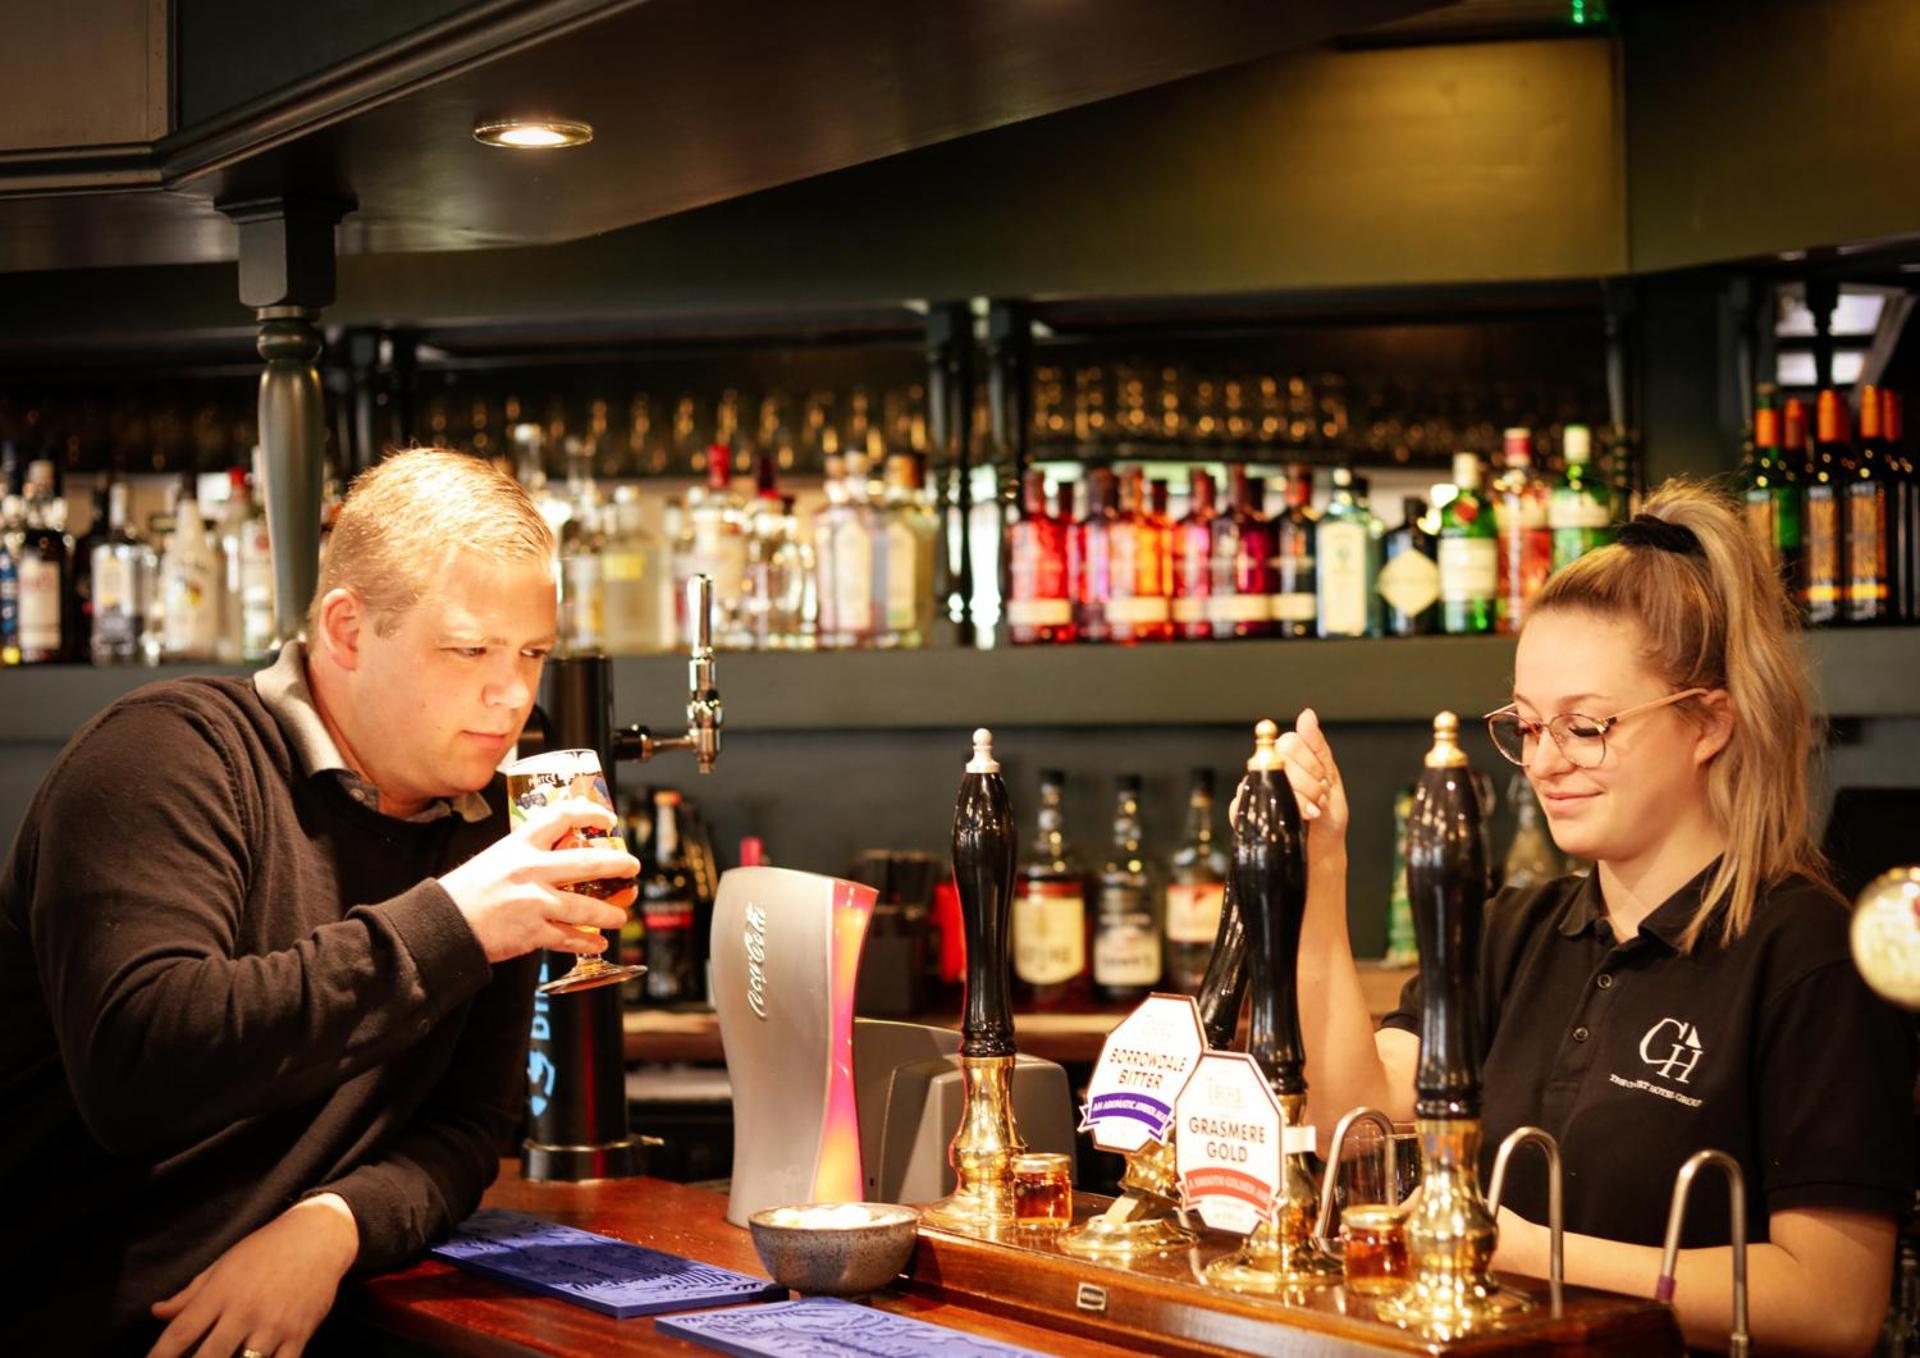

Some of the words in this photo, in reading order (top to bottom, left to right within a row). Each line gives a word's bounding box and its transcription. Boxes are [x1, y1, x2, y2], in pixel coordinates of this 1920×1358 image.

[1109, 1047, 1188, 1072] BORROWDALE
[1118, 1069, 1164, 1088] BITTER
[1188, 1116, 1266, 1144] GRASMERE
[1206, 1141, 1248, 1163] GOLD
